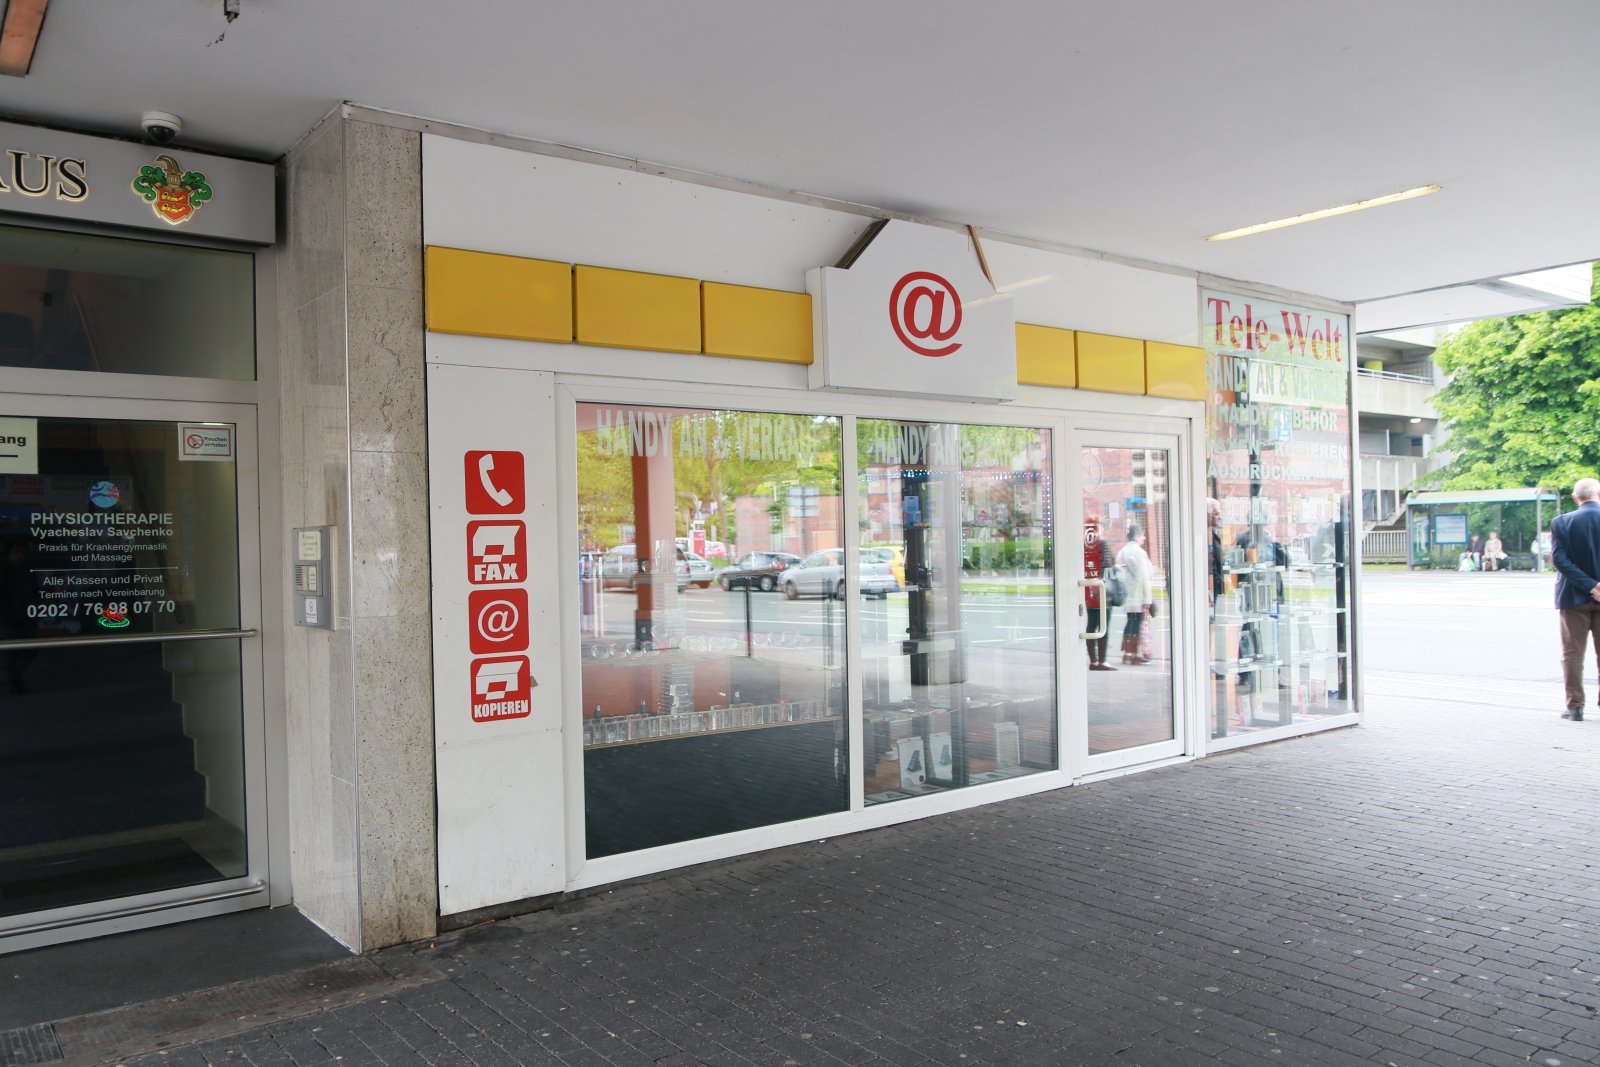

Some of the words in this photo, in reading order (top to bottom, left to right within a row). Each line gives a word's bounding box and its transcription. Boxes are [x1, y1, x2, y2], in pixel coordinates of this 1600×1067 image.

[0, 149, 89, 202] US
[889, 271, 963, 357] @
[1207, 297, 1342, 362] Tele-Welt
[597, 408, 672, 458] HANDY
[679, 414, 709, 459] AN
[875, 423, 930, 465] HANDY
[31, 513, 173, 525] PHYSIOTHERAPIE
[31, 527, 104, 539] Vyacheslav
[107, 527, 174, 537] Savchenko
[39, 544, 69, 552] Praxis
[71, 543, 84, 552] für
[86, 543, 168, 553] Krankengymnastik
[71, 554, 89, 562] und
[91, 554, 133, 562] Massage
[43, 576, 64, 586] Alle
[67, 576, 108, 585] Kassen
[110, 575, 131, 584] und
[133, 574, 164, 583] Privat
[474, 563, 519, 582] FAX
[39, 590, 78, 599] Termine
[80, 589, 103, 598] nach
[105, 588, 165, 597] Vereinbarung
[27, 604, 69, 618] 0202
[83, 603, 104, 616] 76
[108, 602, 128, 615] 98
[133, 601, 152, 614] 07
[156, 600, 176, 613] 70
[478, 600, 519, 642] @
[474, 699, 529, 718] KOPIEREN
